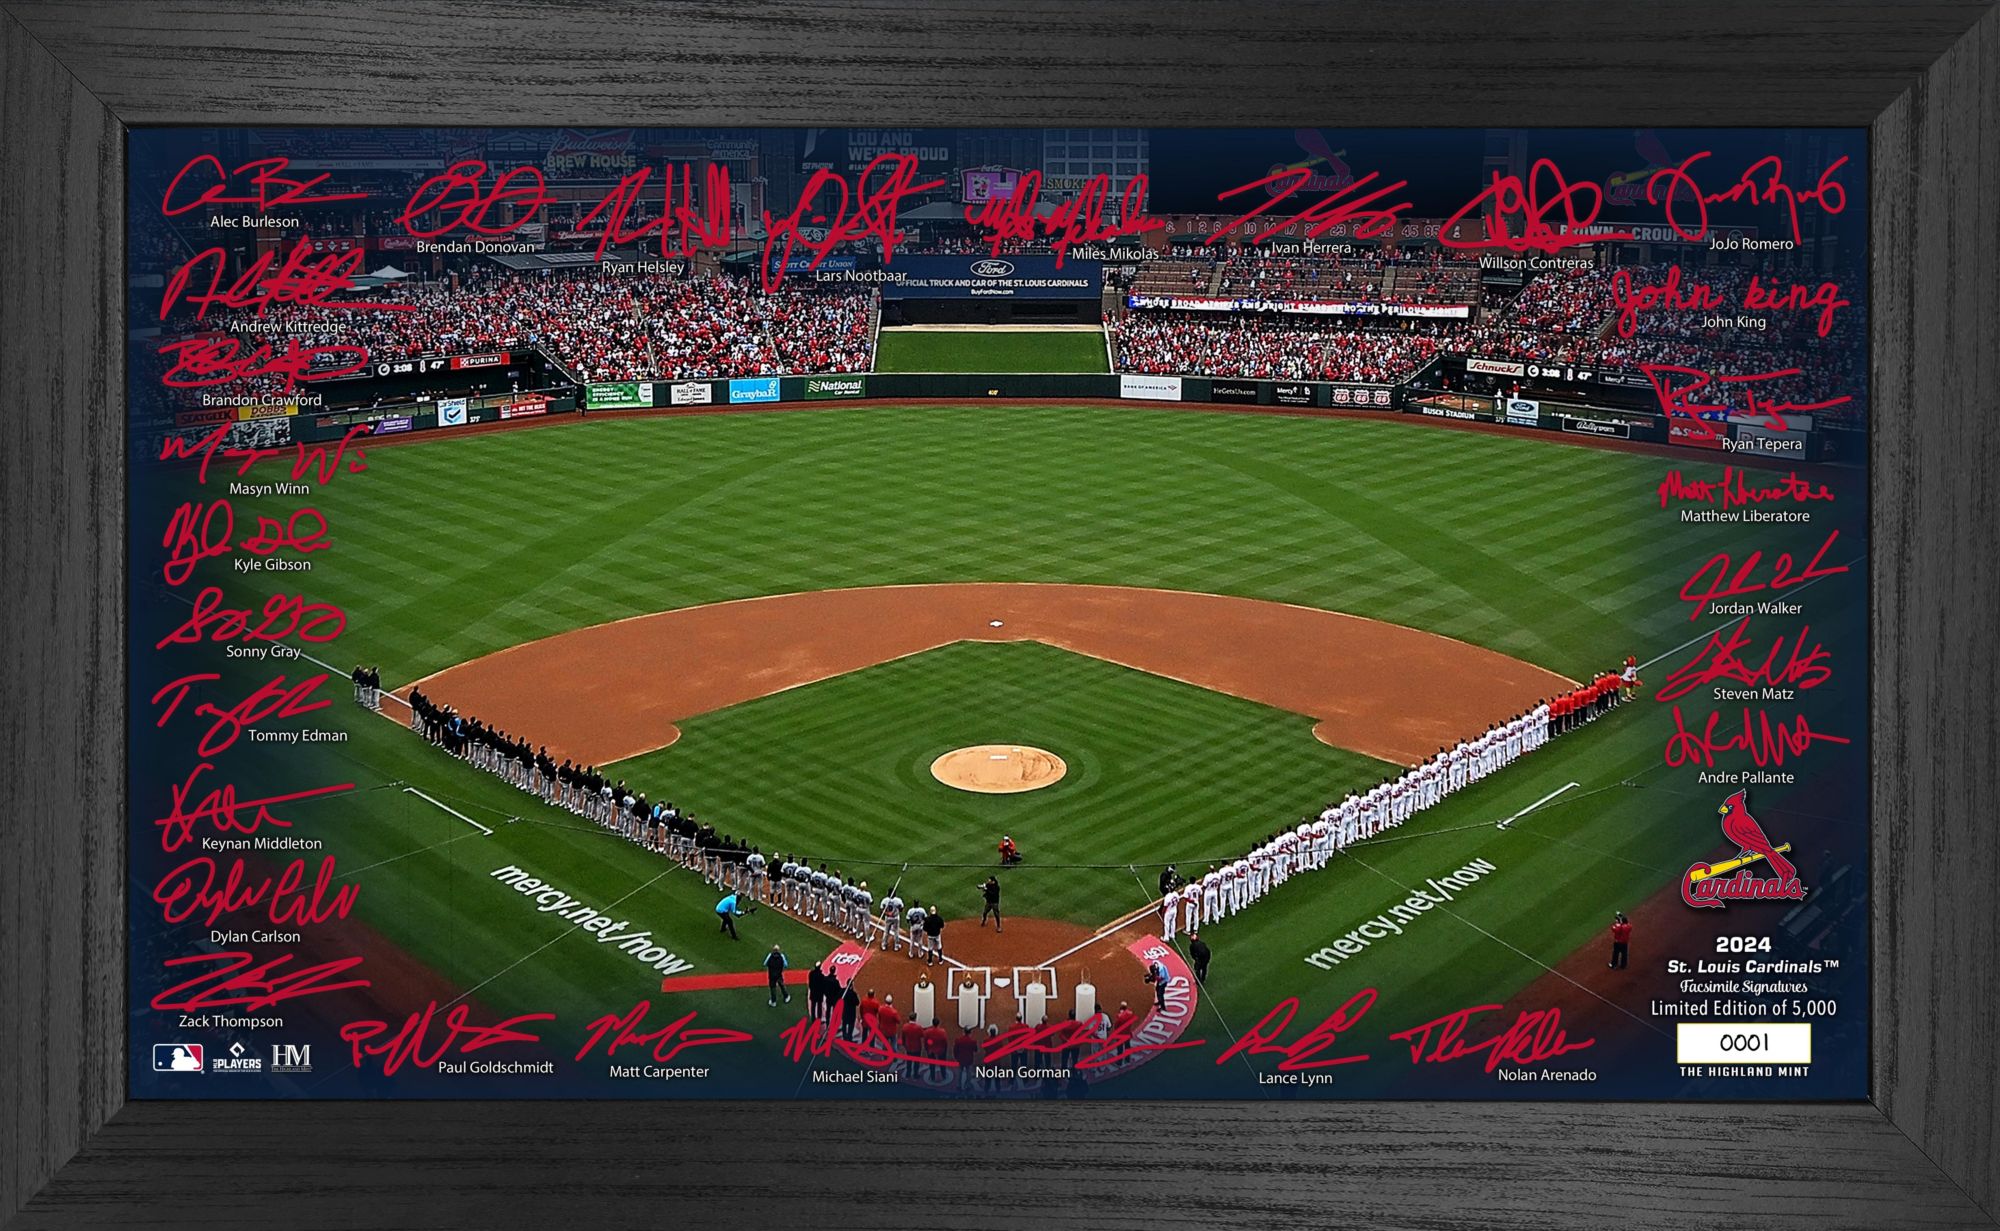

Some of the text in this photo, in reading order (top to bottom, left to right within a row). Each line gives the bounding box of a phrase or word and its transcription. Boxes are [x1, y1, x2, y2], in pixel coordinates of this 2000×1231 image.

[848, 133, 913, 146] LOU AND
[546, 155, 637, 168] BREW HOUSE
[1244, 222, 1257, 235] 10
[1401, 225, 1418, 237] 45
[977, 260, 1007, 275] Ford
[896, 279, 1088, 288] OFFICIAL TRUCK AND CAR OF THE ST. LOUIS CARDINALS
[1611, 265, 1723, 338] John
[470, 356, 500, 365] PURINA
[1469, 362, 1519, 374] Schnucks
[819, 380, 863, 392] National
[1213, 387, 1257, 397] HeGetsUs.com
[1277, 386, 1294, 396] Mercy
[1423, 406, 1475, 420] BUSCH STADIUM
[1514, 402, 1531, 412] Ford
[489, 864, 695, 977] mercy.net/now
[1303, 857, 1497, 971] mercy.net/now
